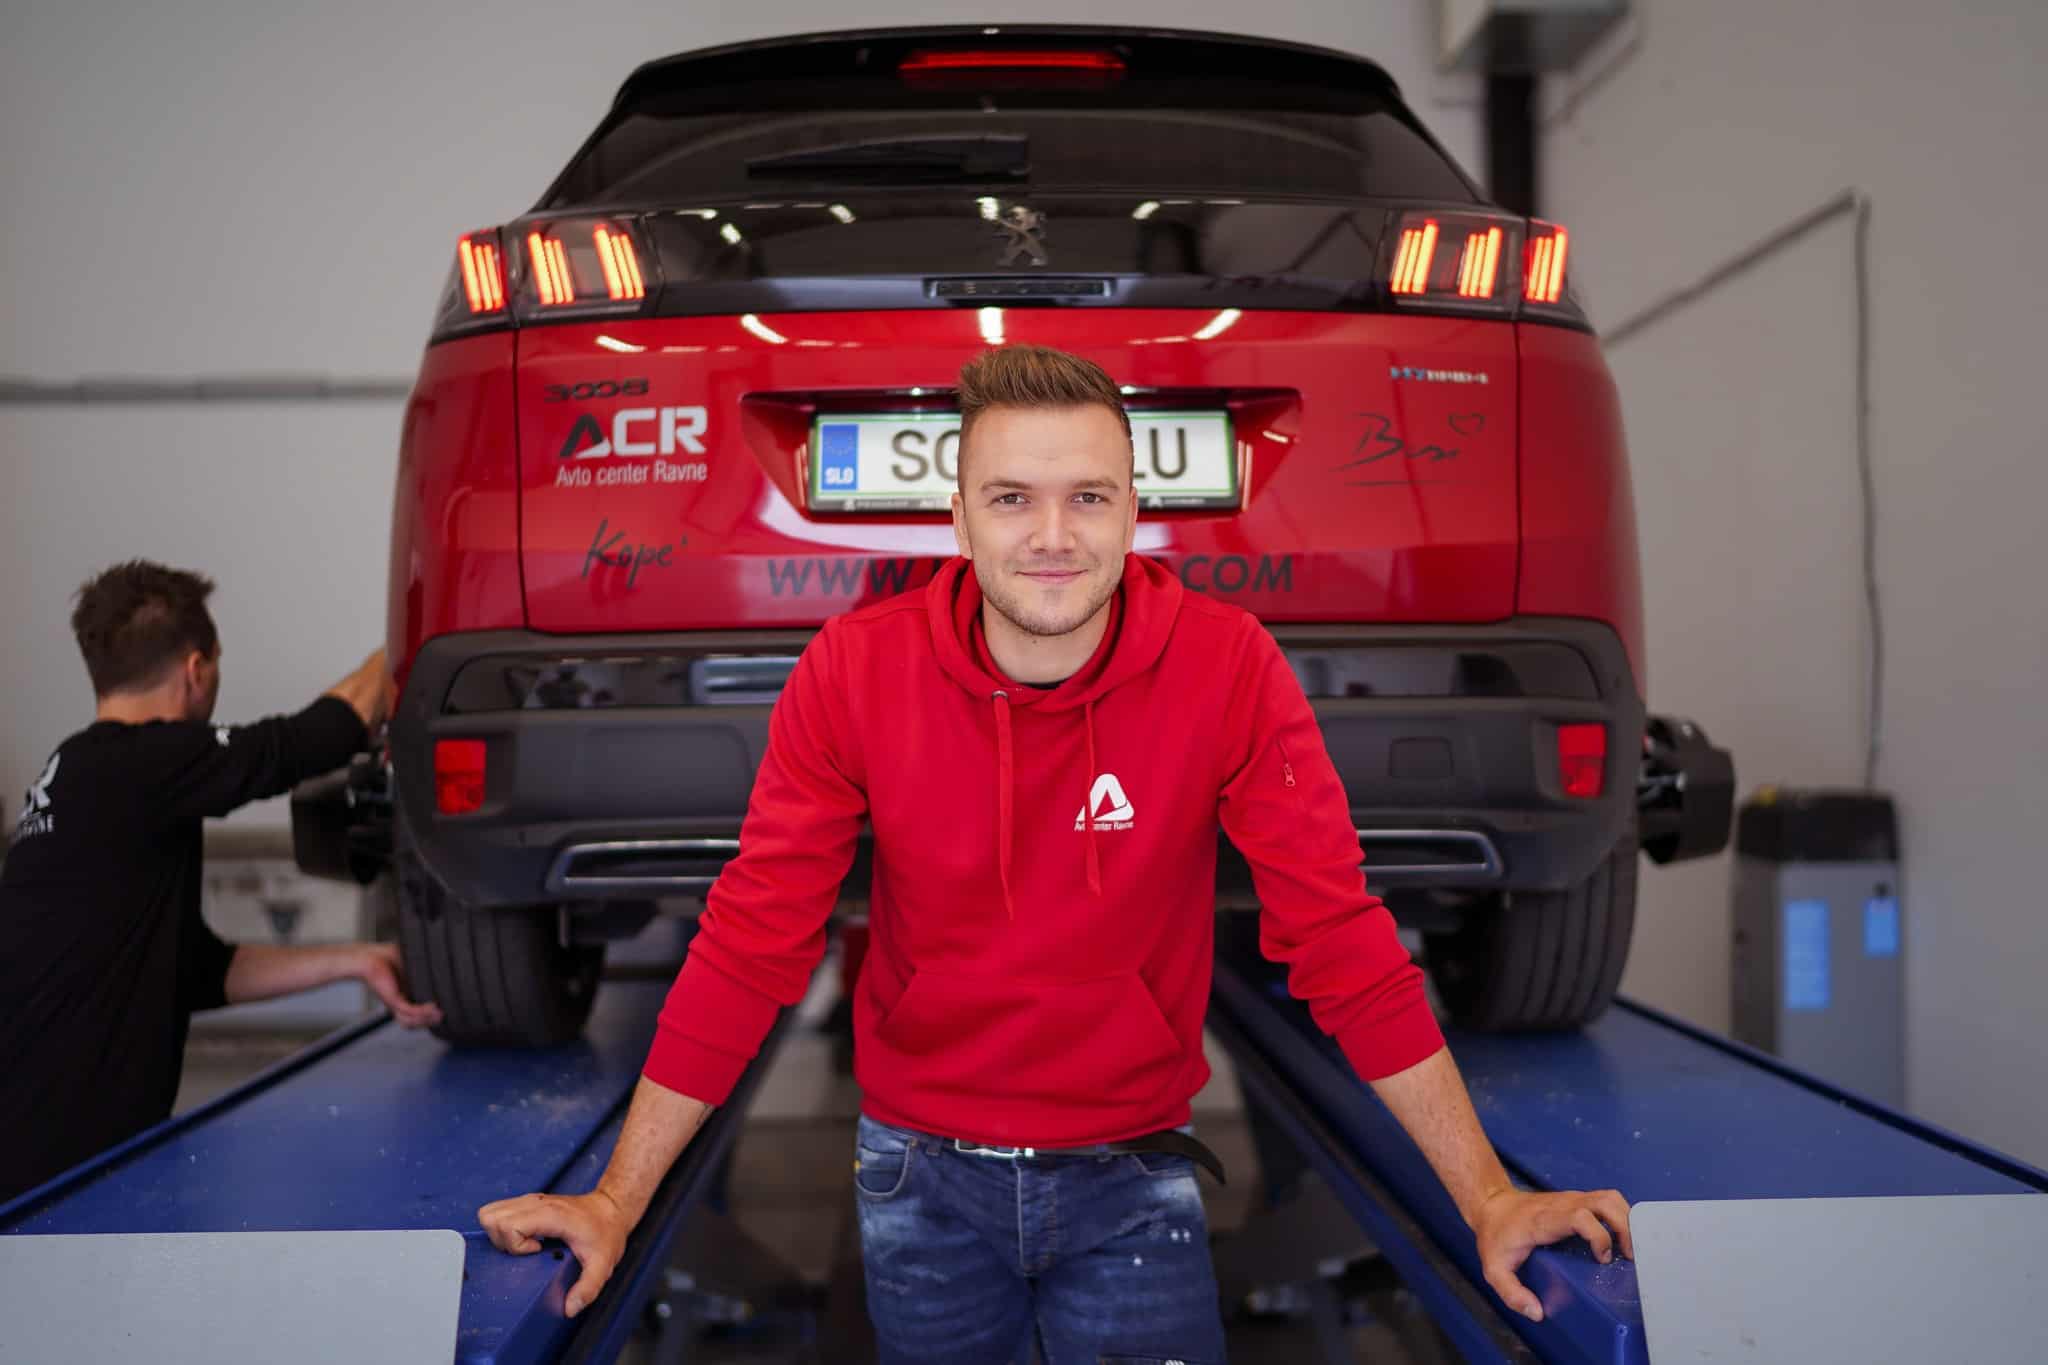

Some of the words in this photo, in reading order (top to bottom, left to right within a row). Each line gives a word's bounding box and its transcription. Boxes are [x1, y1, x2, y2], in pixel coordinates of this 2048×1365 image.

[544, 378, 650, 402] 3008
[559, 406, 708, 459] ACR
[1134, 427, 1187, 479] U
[555, 465, 592, 488] Avto
[596, 461, 649, 485] center
[653, 459, 708, 482] Ravne
